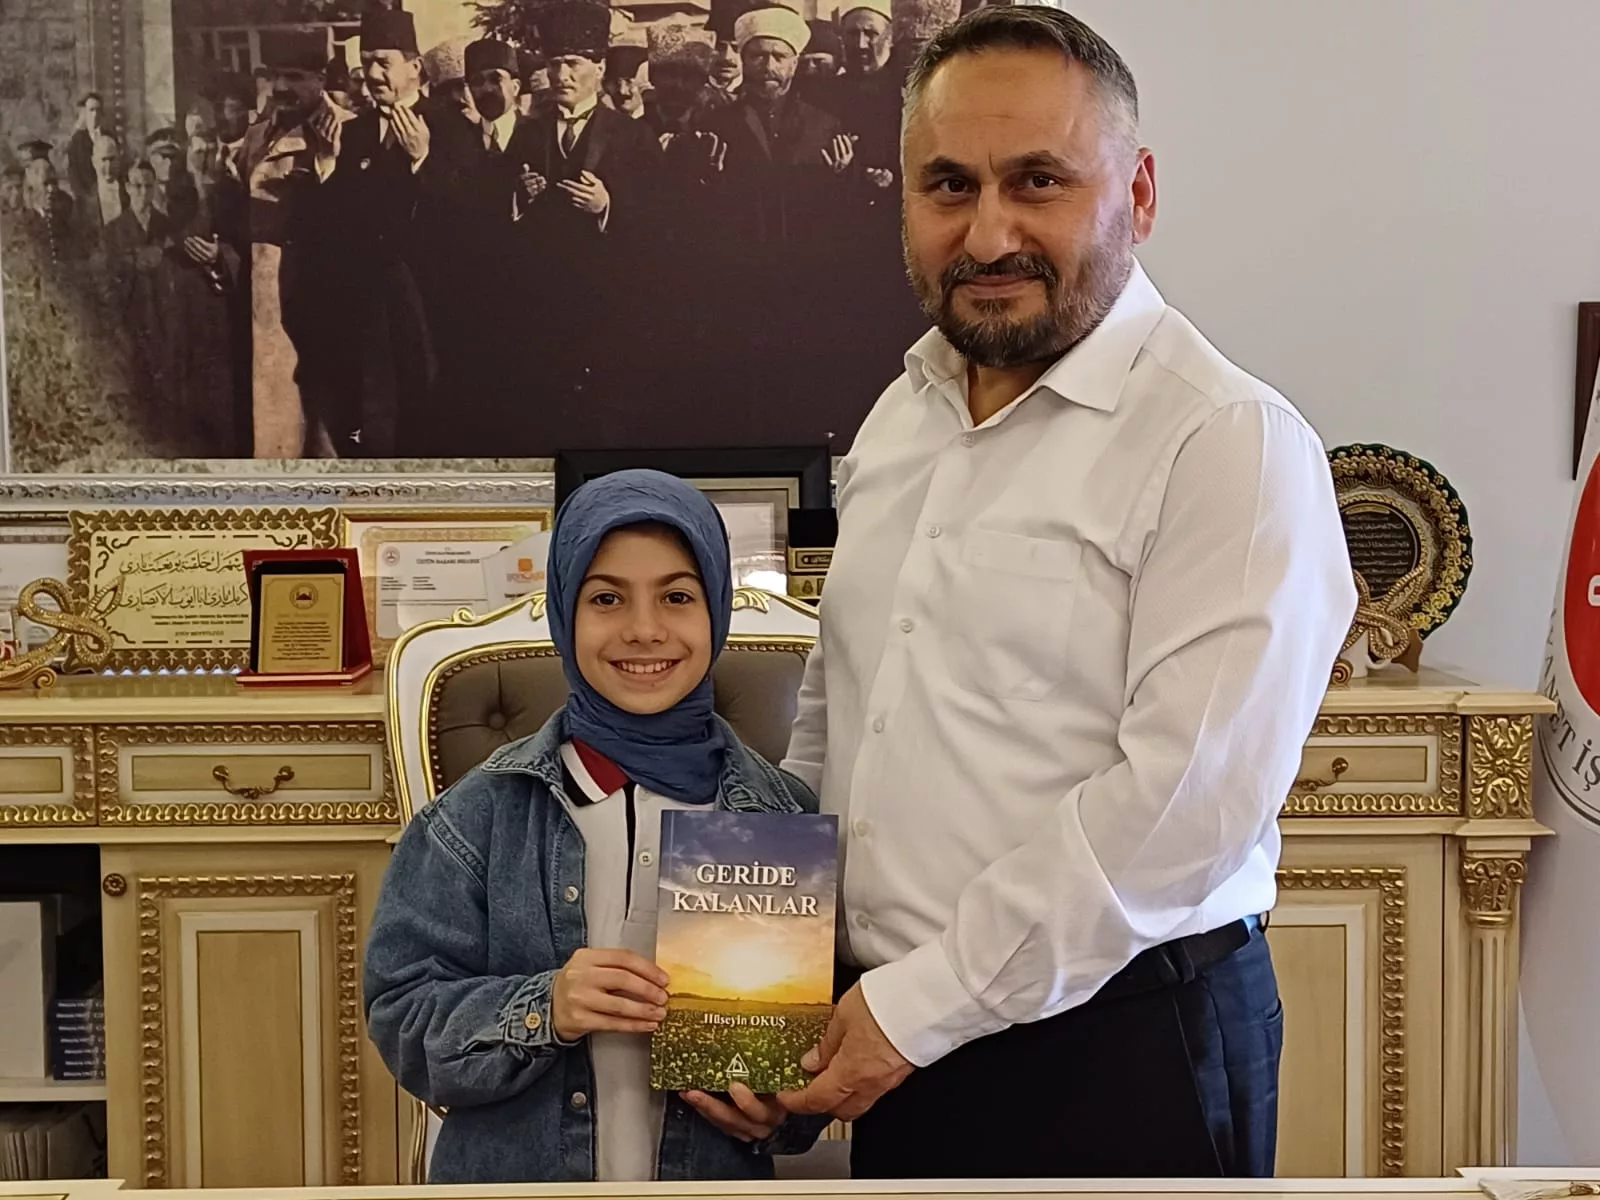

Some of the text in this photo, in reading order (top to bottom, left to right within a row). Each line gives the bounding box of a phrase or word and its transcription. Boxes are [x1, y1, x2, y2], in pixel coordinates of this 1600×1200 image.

[696, 860, 797, 886] GERİDE
[672, 891, 819, 917] KALANLAR
[704, 1013, 786, 1029] Hüseyin OKUŞ
